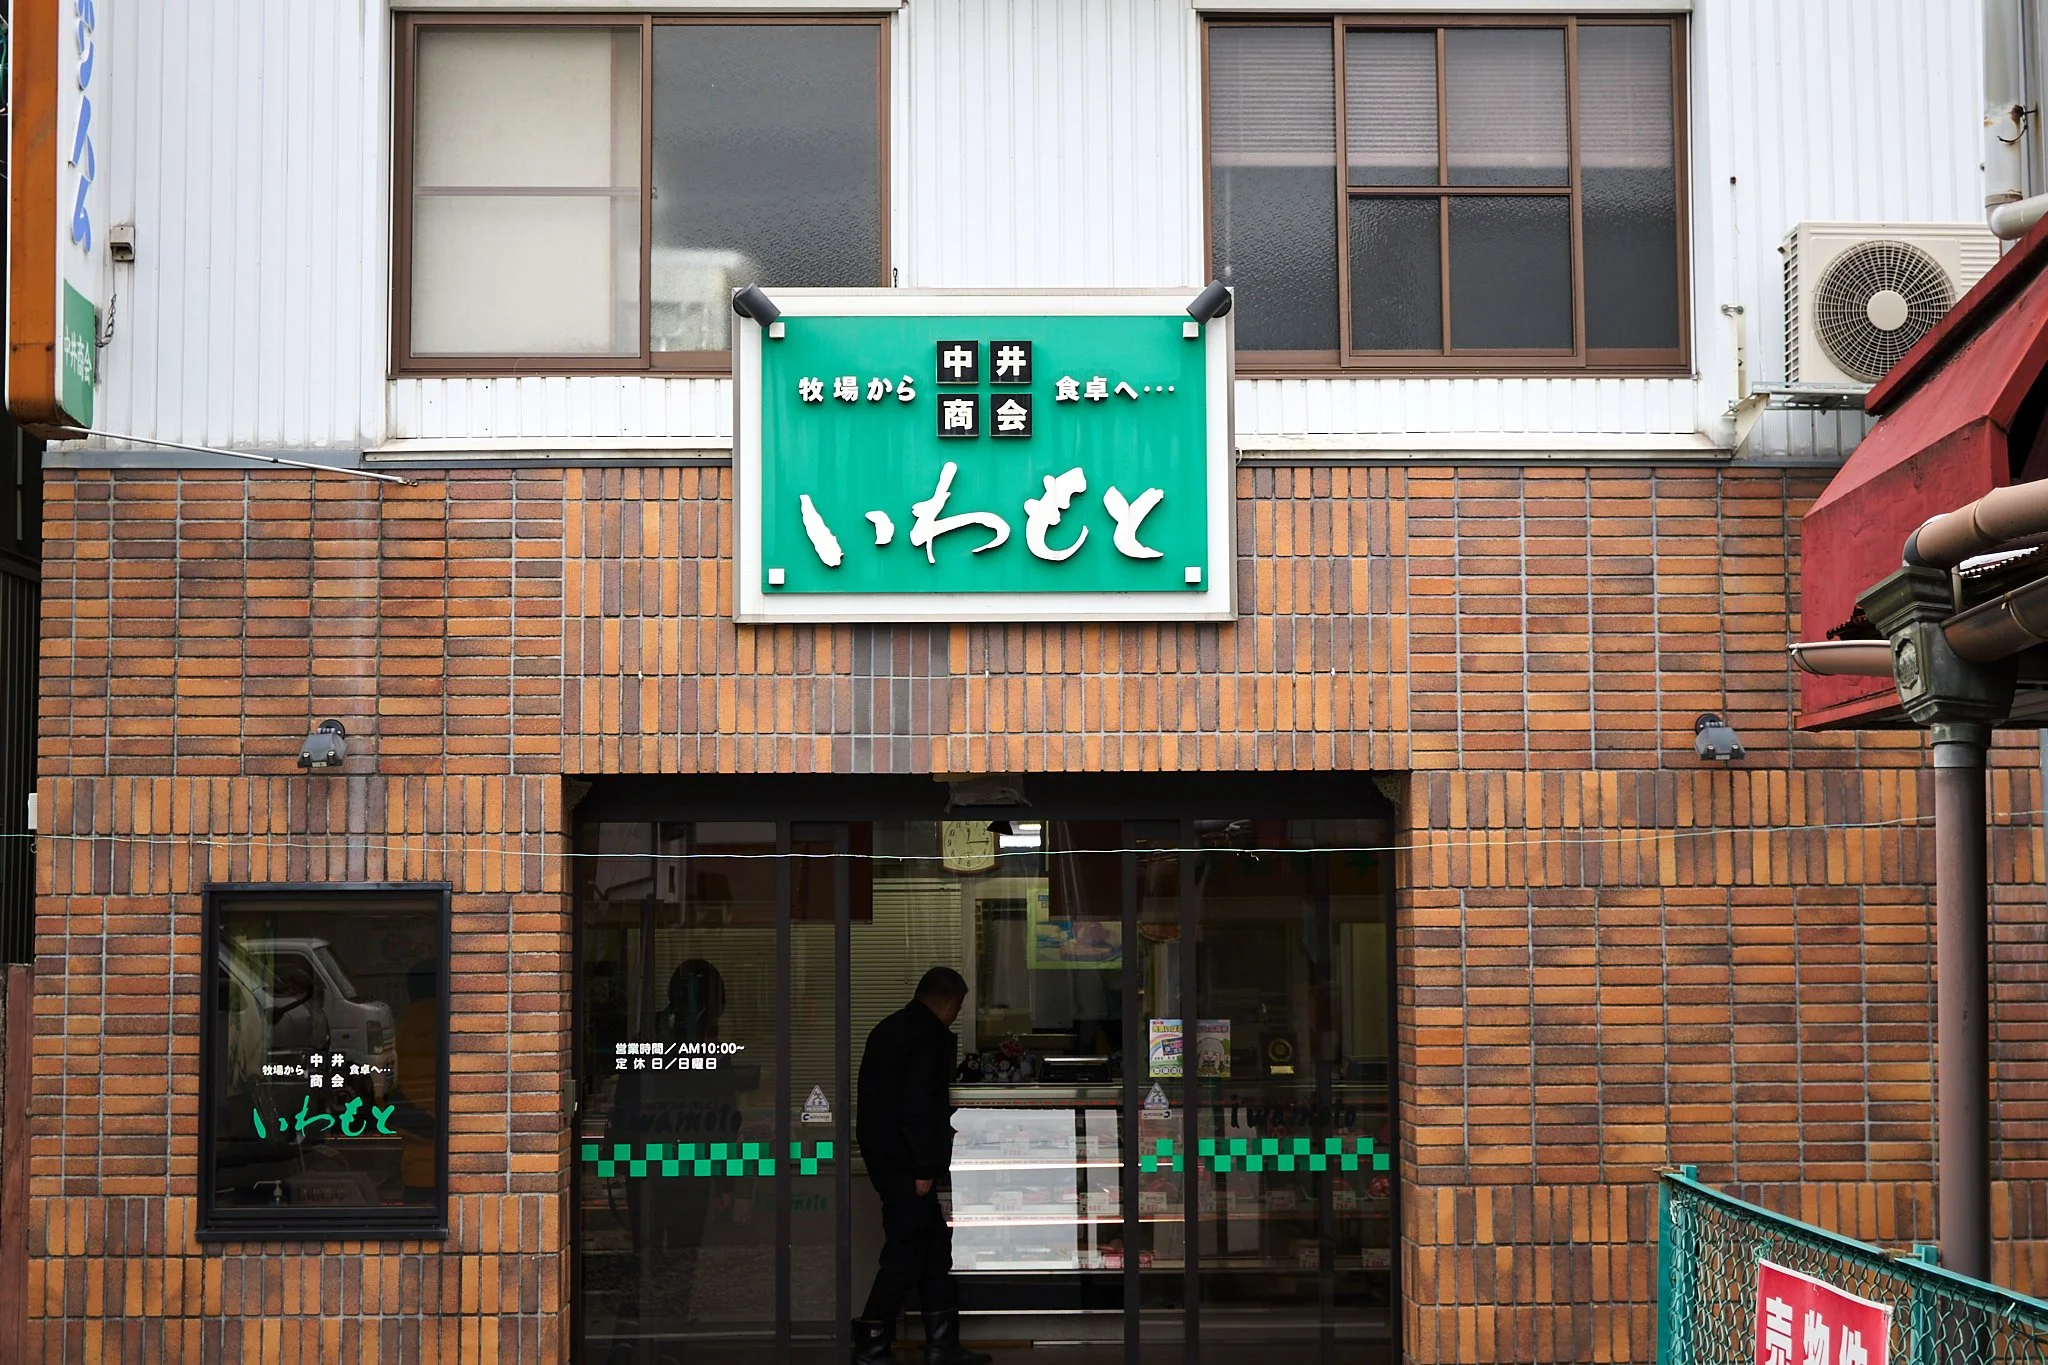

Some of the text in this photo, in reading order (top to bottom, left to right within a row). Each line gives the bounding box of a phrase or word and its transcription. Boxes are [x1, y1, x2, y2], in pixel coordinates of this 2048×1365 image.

[64, 323, 92, 385] 中井商会
[943, 344, 1027, 377] 中井
[798, 375, 917, 403] 牧場から
[943, 398, 1028, 432] 商会
[799, 461, 1165, 568] いわもと
[262, 1064, 304, 1076] 牧場から
[310, 1053, 345, 1067] 中井
[310, 1074, 345, 1088] 商会
[253, 1094, 397, 1138] いわもと
